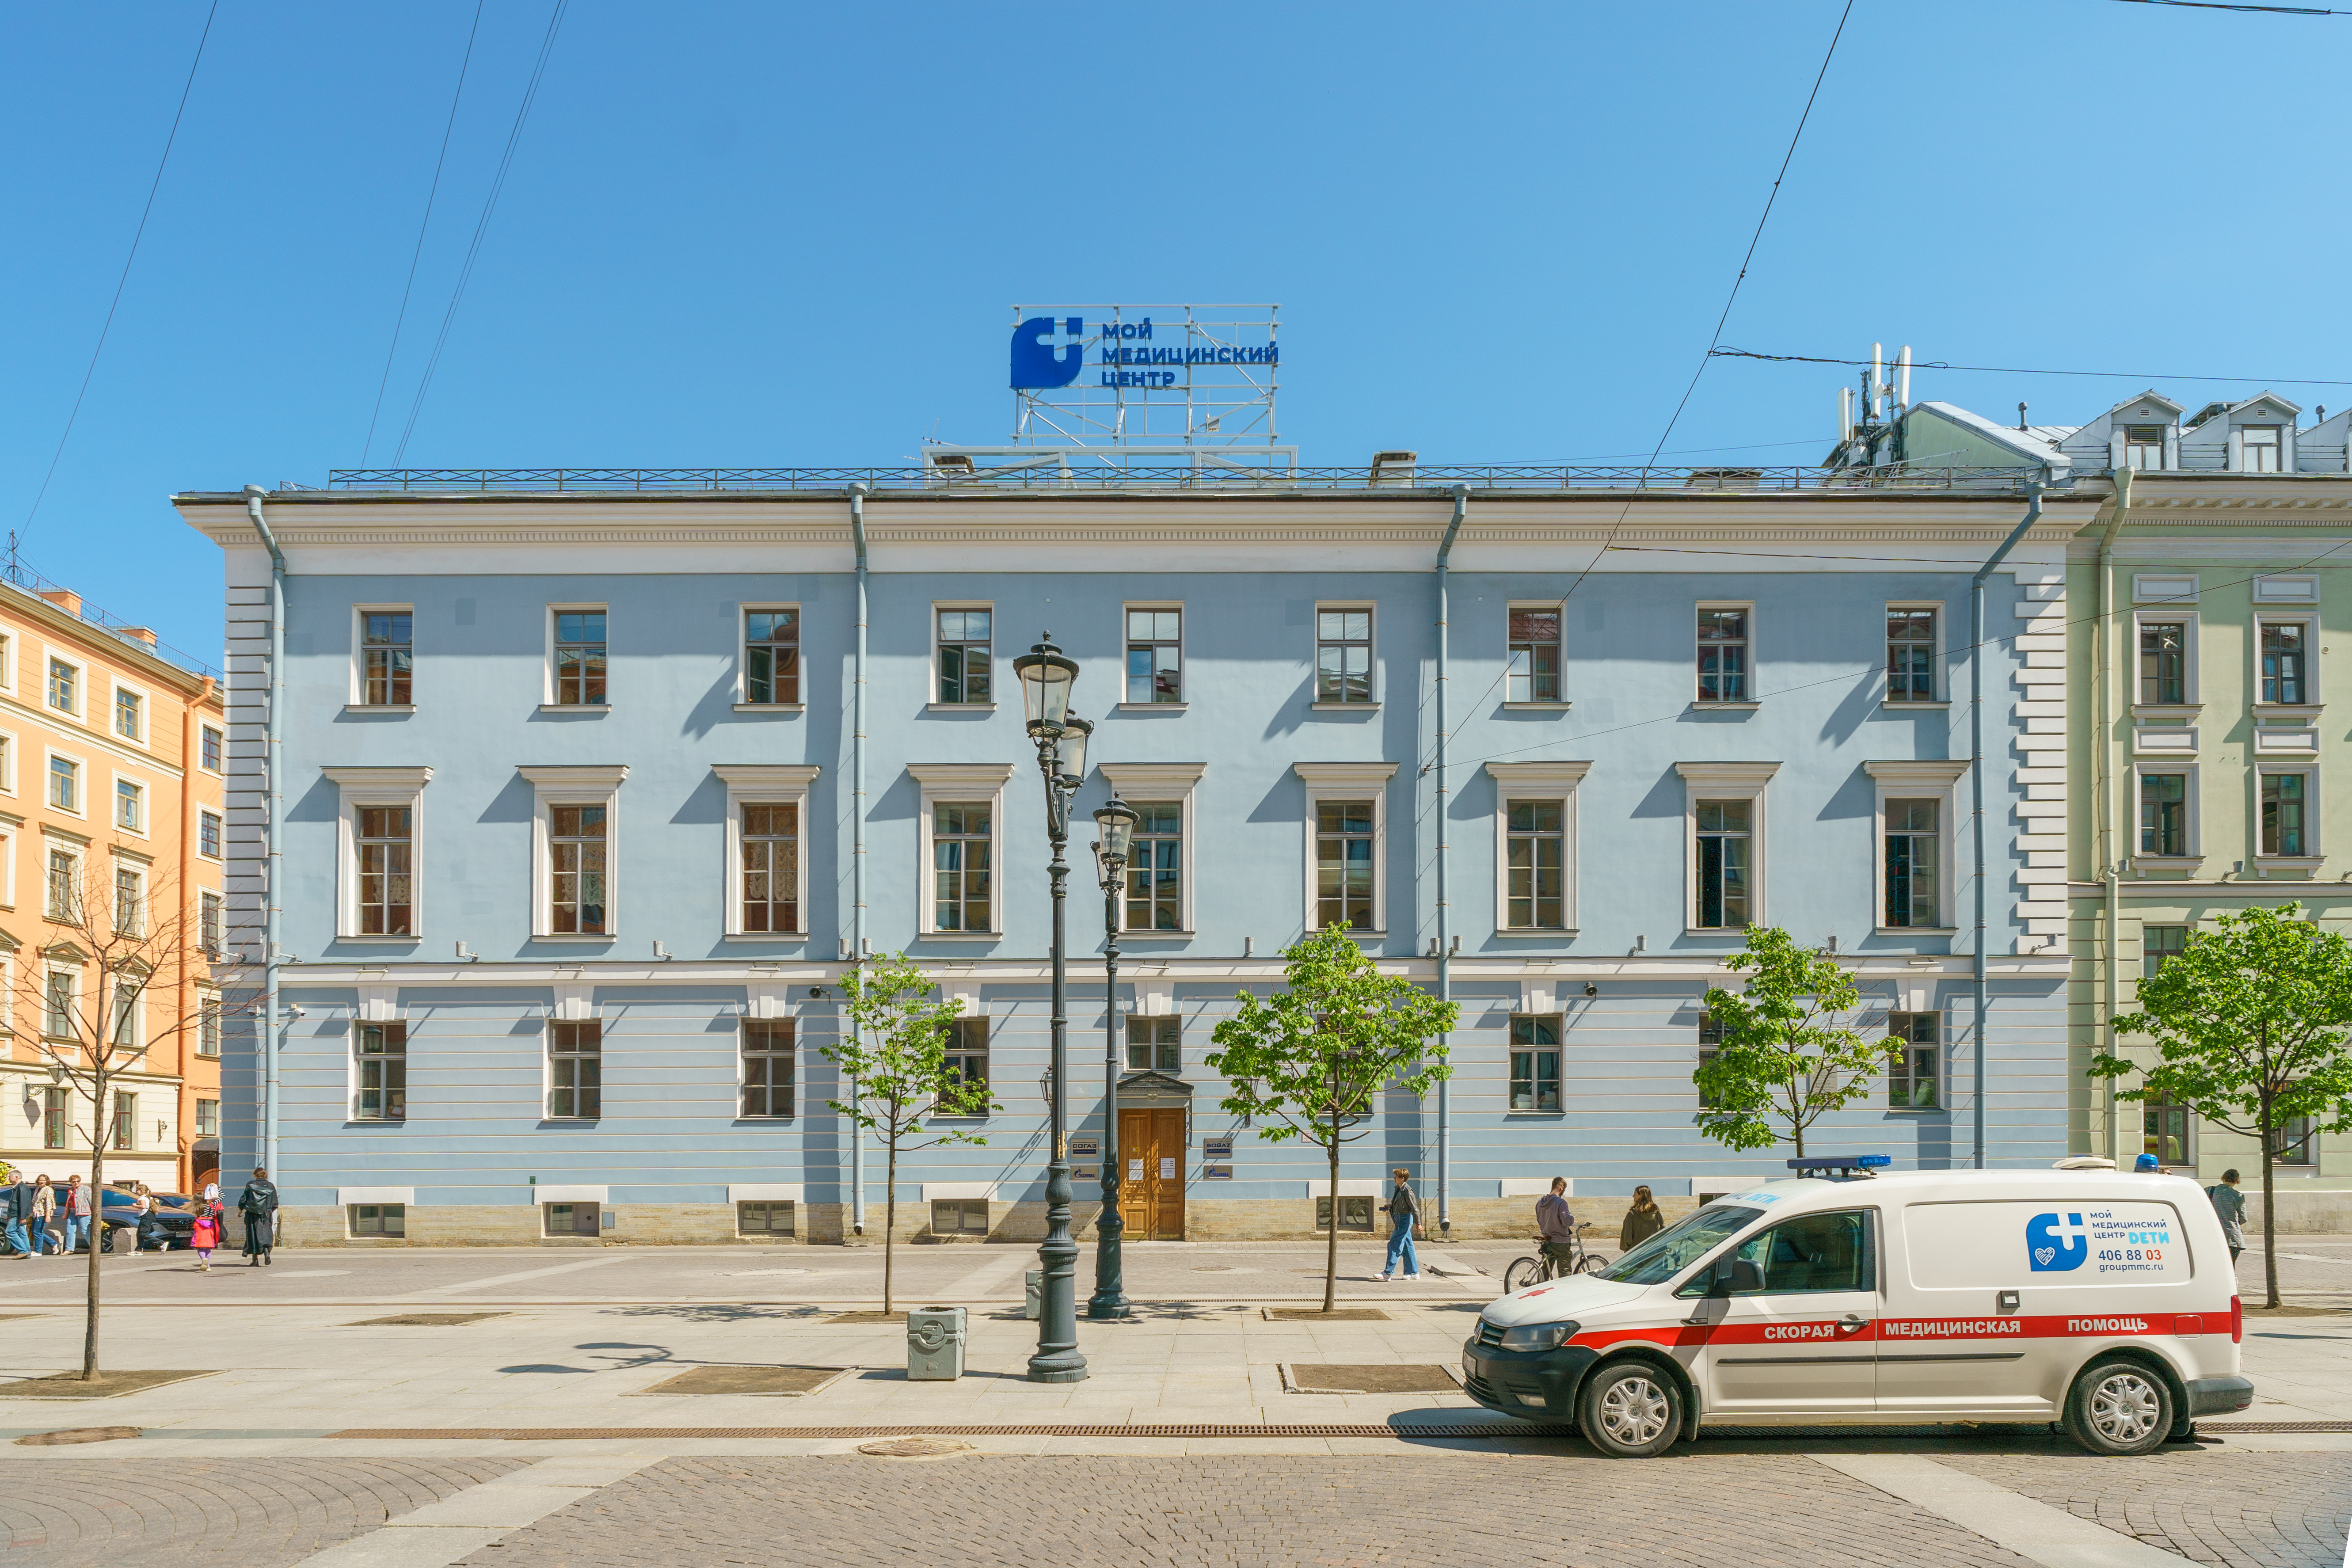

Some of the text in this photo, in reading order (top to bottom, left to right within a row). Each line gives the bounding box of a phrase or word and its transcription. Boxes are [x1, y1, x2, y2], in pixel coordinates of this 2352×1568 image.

[1102, 318, 1152, 339] МОЙ
[1102, 342, 1279, 365] МЕДИЦИНСКИЙ
[1102, 372, 1175, 389] ЦЕНТР
[2090, 1210, 2112, 1218] МОЙ
[2092, 1219, 2166, 1229] МЕДИЦИНСКИЙ
[2098, 1249, 2162, 1260] 406 88 03
[2099, 1264, 2163, 1272] groupmmc.ru
[1764, 1318, 2148, 1339] СКОРАЯ МЕДИЦИНСКАЯ ПОМОЩЬ
